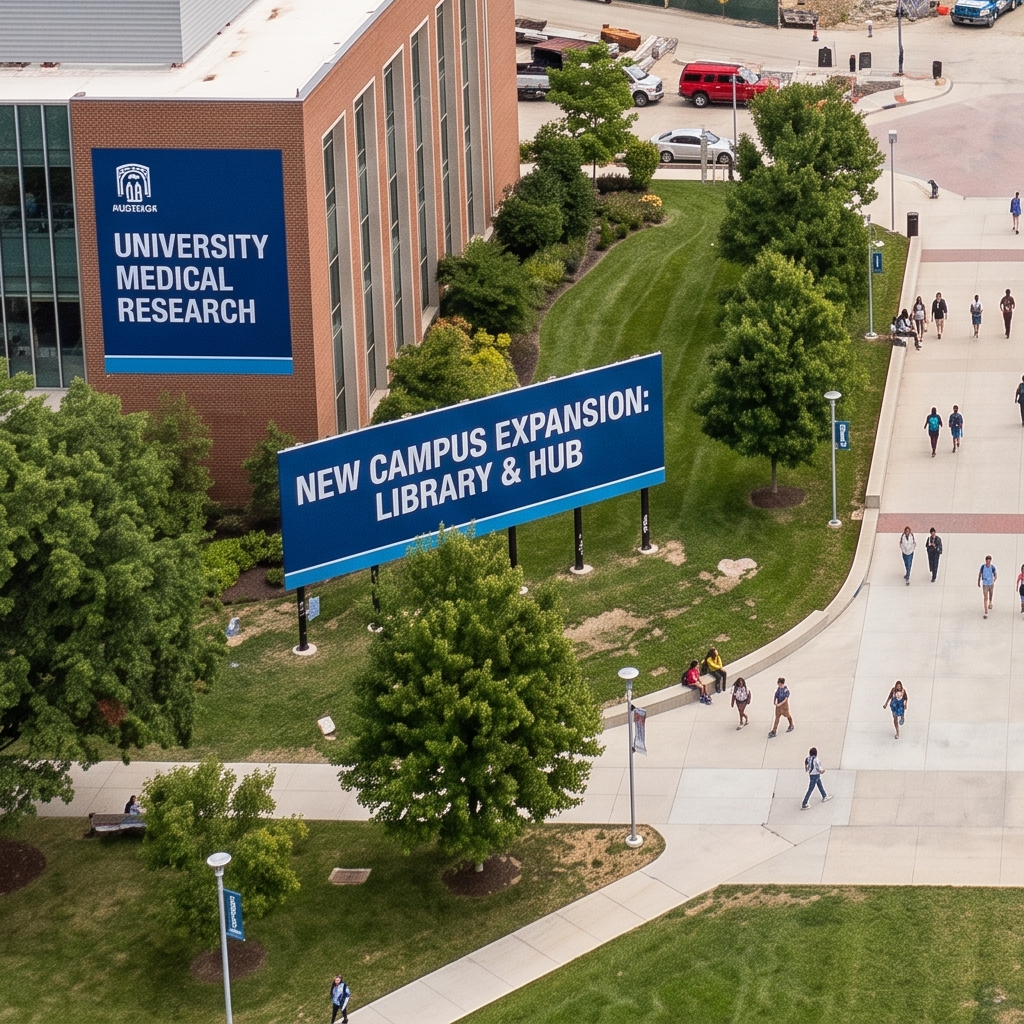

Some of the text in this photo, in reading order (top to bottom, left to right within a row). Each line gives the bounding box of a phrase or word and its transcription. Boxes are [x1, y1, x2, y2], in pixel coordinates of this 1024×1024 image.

[114, 232, 269, 259] UNIVERSITY
[116, 265, 234, 291] MEDICAL
[117, 297, 256, 324] RESEARCH
[296, 385, 650, 506] NEW CAMPUS EXPANSION:
[375, 439, 583, 522] LIBRARY & HUB
